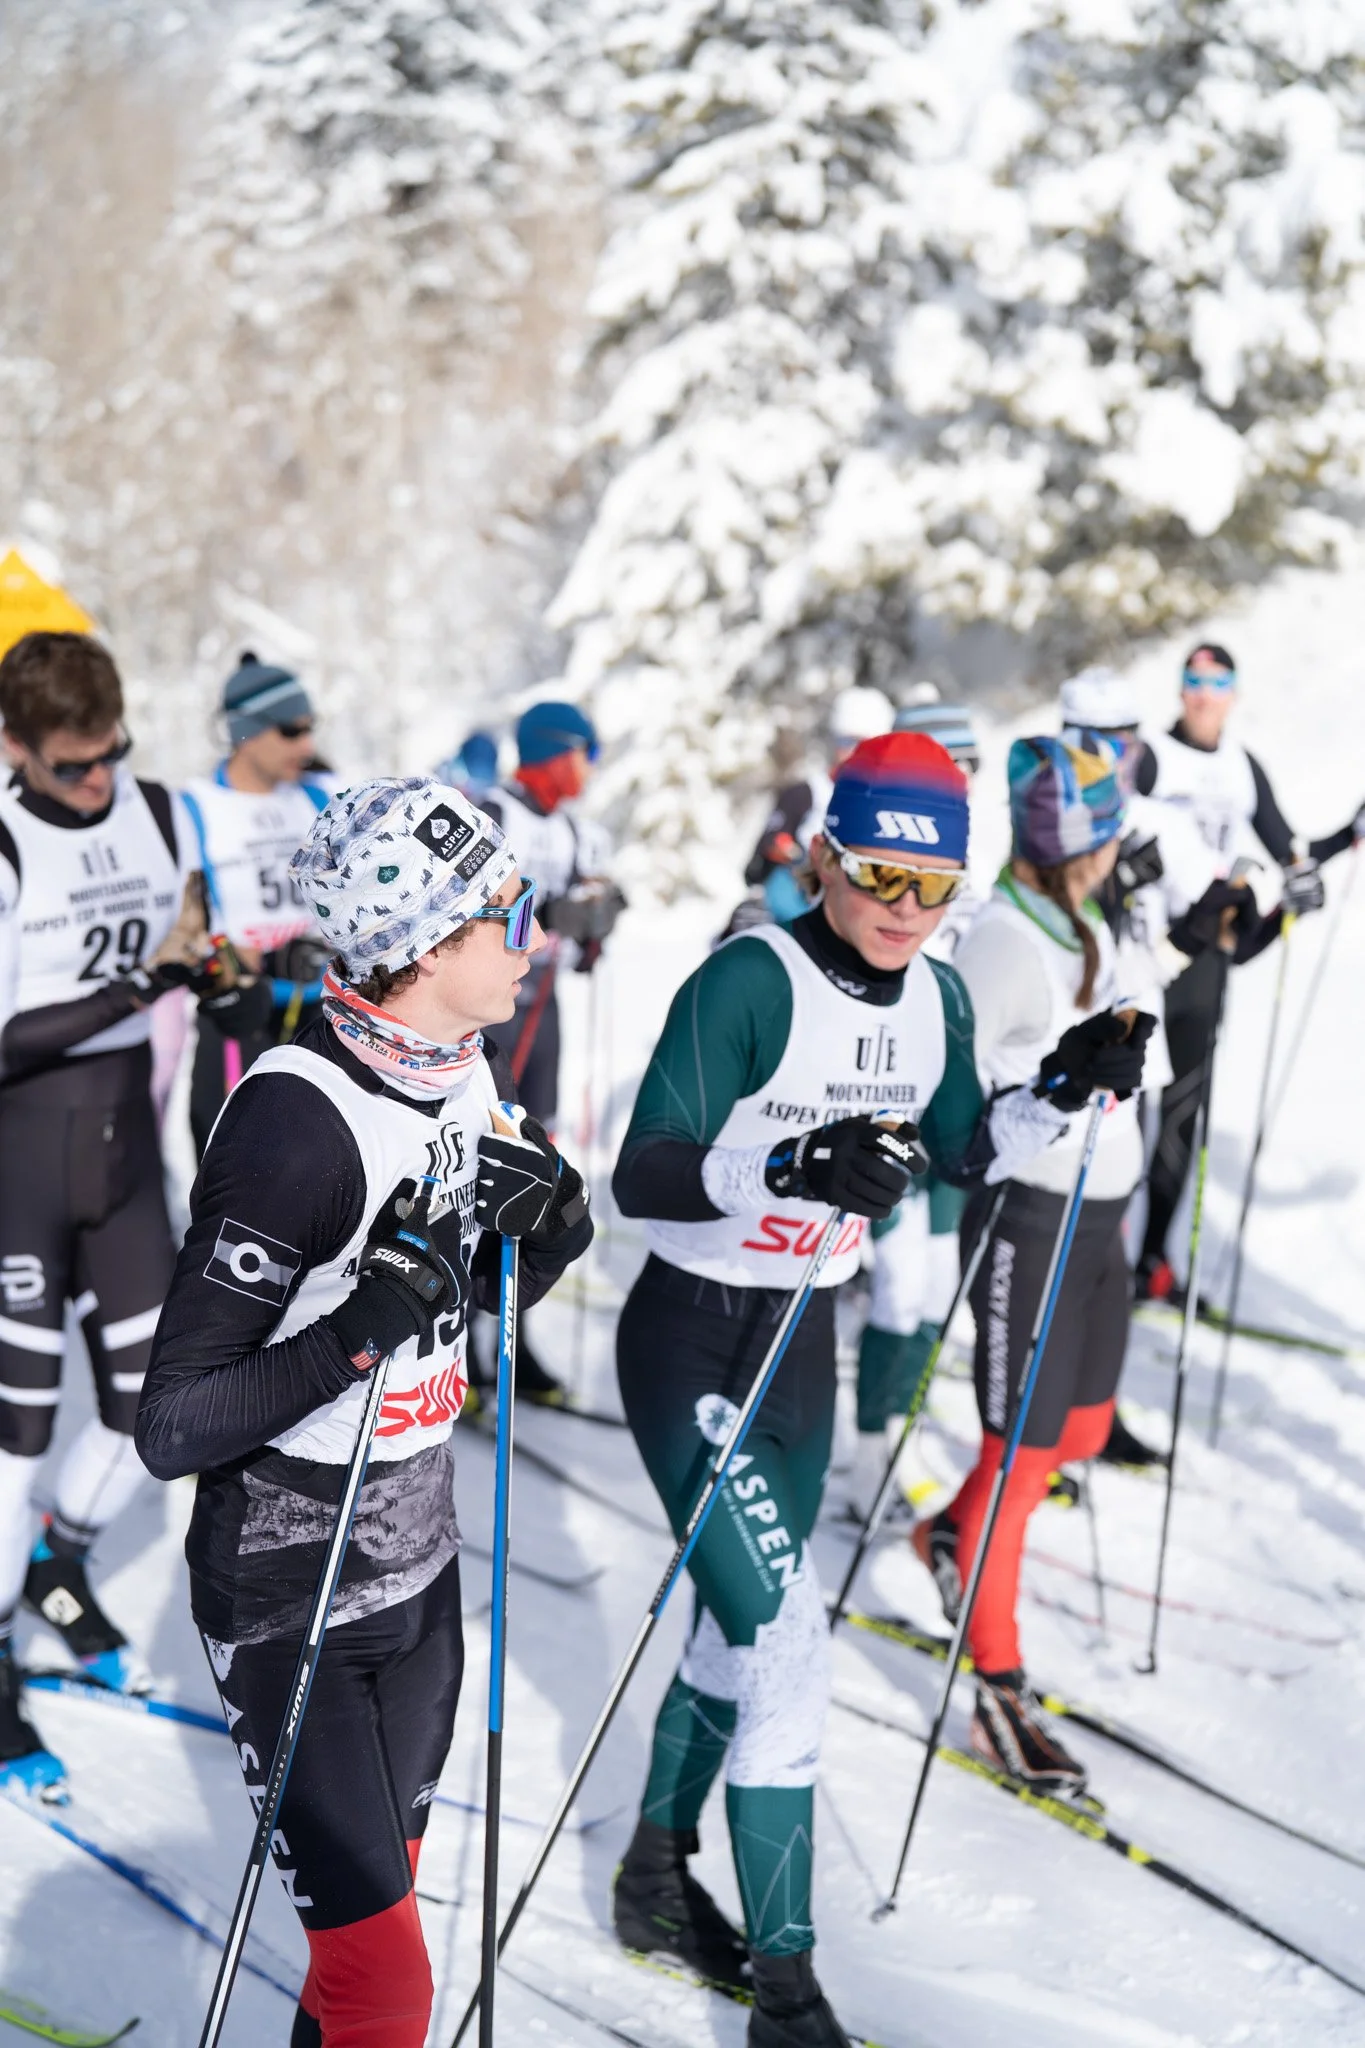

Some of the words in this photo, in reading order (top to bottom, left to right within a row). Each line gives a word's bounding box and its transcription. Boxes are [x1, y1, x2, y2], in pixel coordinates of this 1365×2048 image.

[440, 824, 467, 855] ASPEN
[463, 844, 486, 869] SKIDA
[77, 918, 148, 982] 29
[824, 1083, 918, 1103] MOUNTAINEER
[759, 1100, 820, 1125] ASPEN
[370, 1247, 419, 1274] SWIX
[427, 1279, 437, 1290] R
[727, 1453, 806, 1589] ASPEN
[287, 1660, 310, 1740] SWIX
[259, 1753, 288, 1848] TECHNOLOGY
